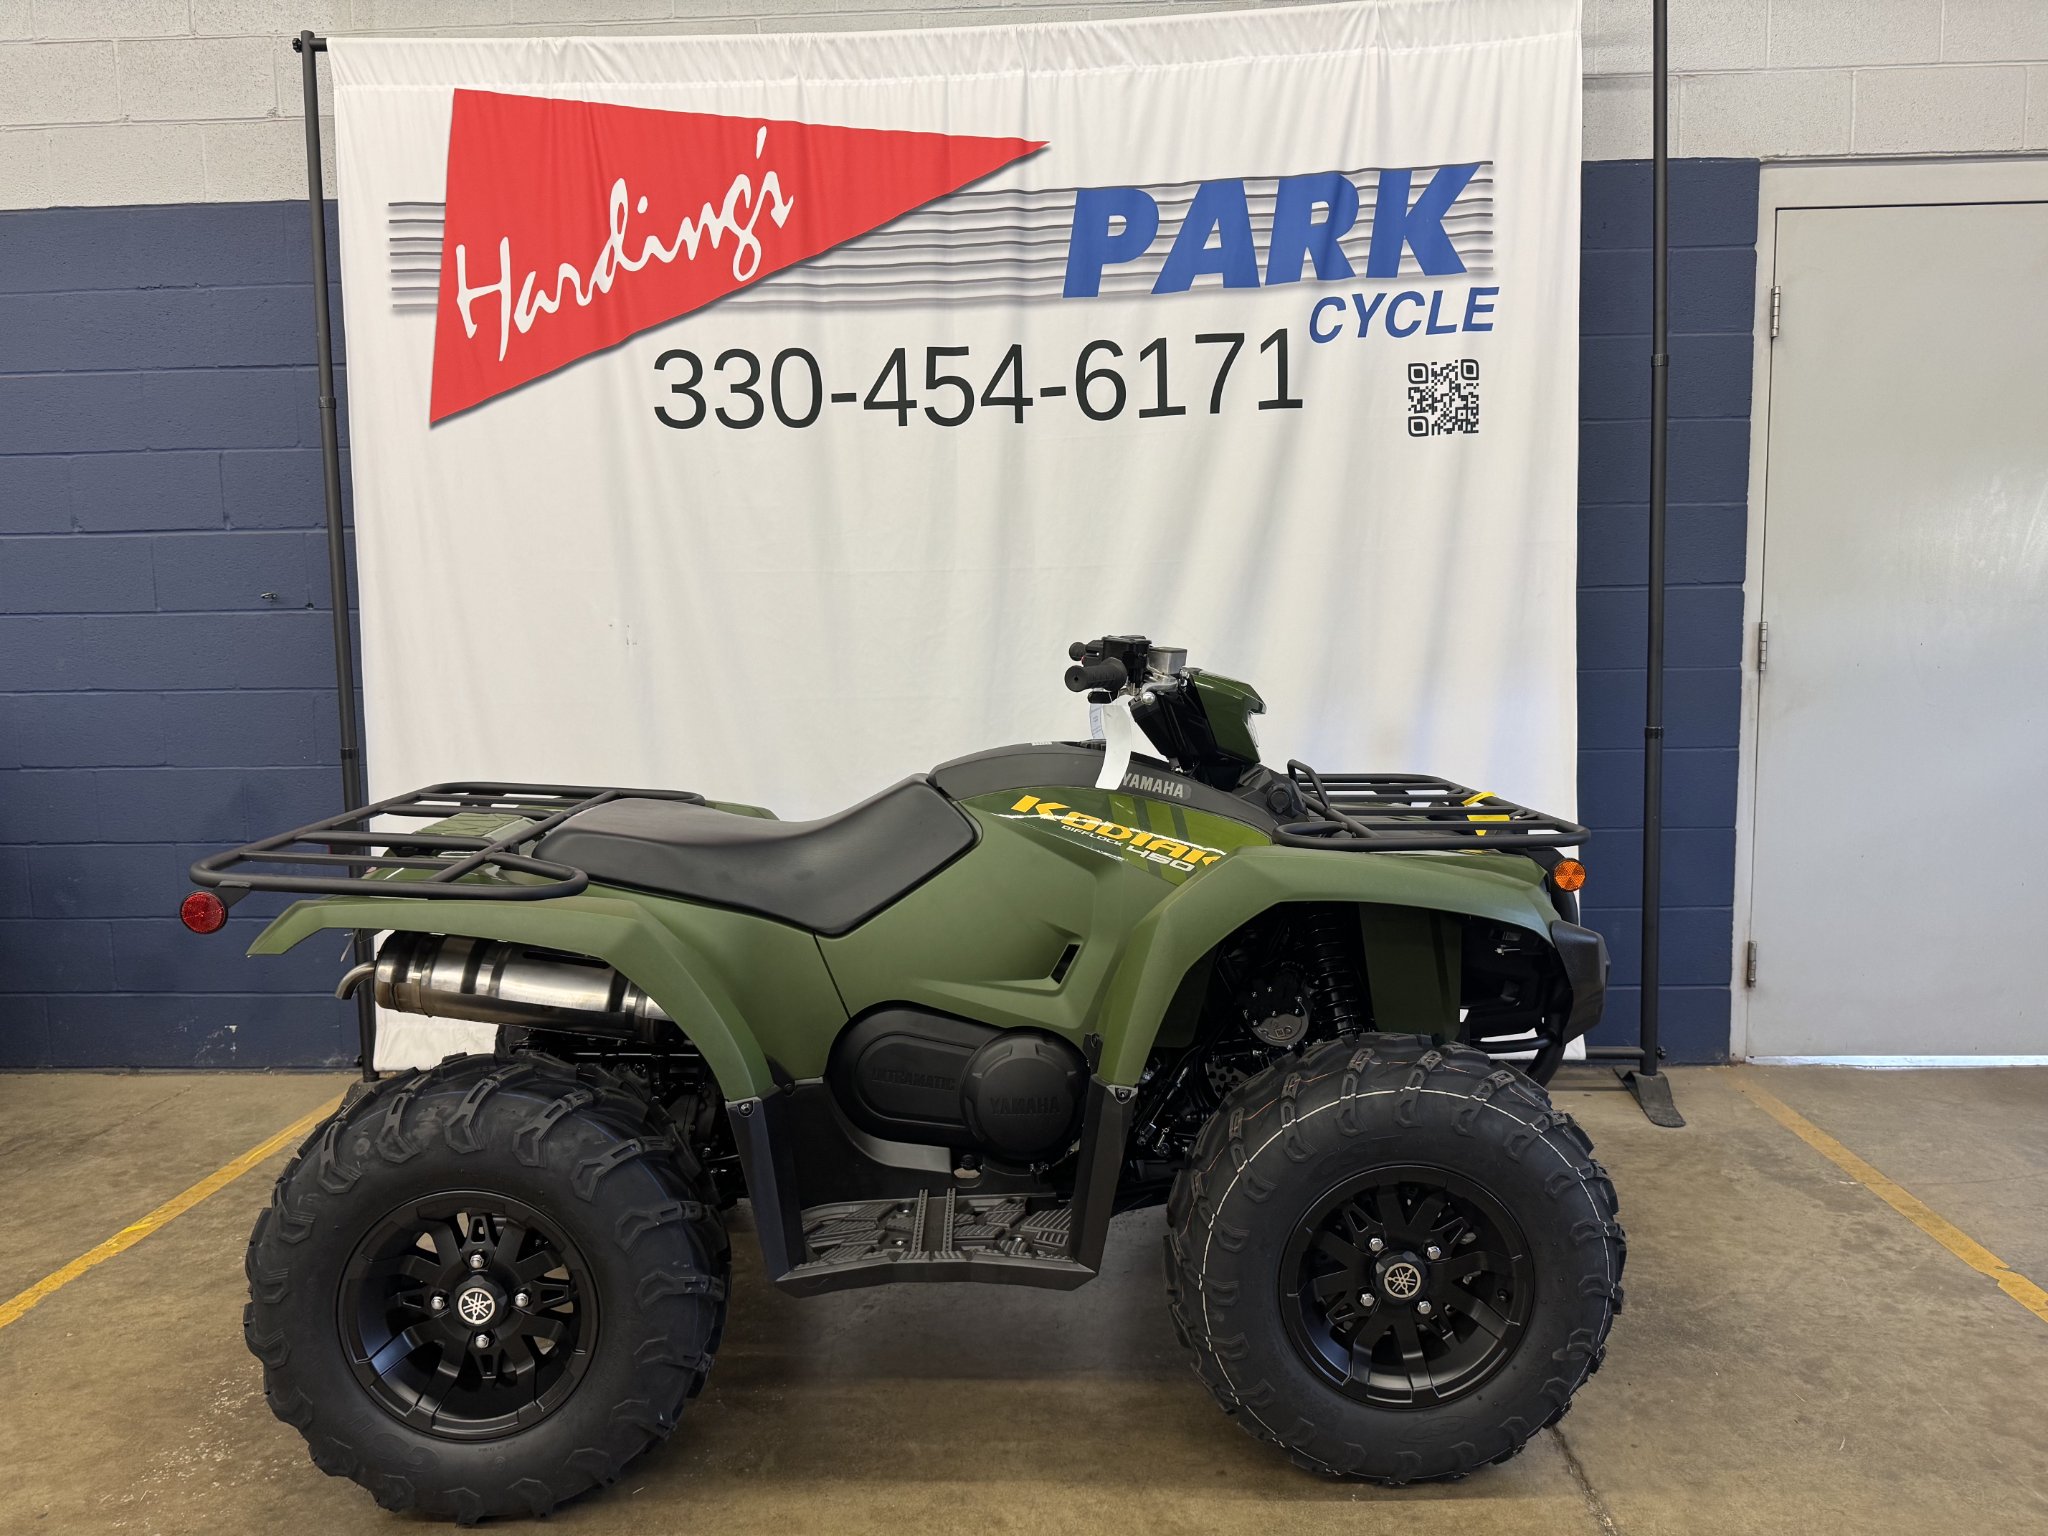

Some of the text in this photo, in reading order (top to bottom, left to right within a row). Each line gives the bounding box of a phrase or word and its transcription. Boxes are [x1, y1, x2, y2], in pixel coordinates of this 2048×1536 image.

[455, 126, 794, 362] Harding's
[1062, 163, 1482, 298] PARK
[1309, 286, 1500, 343] CYCLE
[653, 328, 1303, 429] 330-454-6171
[1122, 772, 1184, 798] YAMAHA
[1126, 845, 1196, 872] 450
[990, 1095, 1062, 1115] YAMAHA
